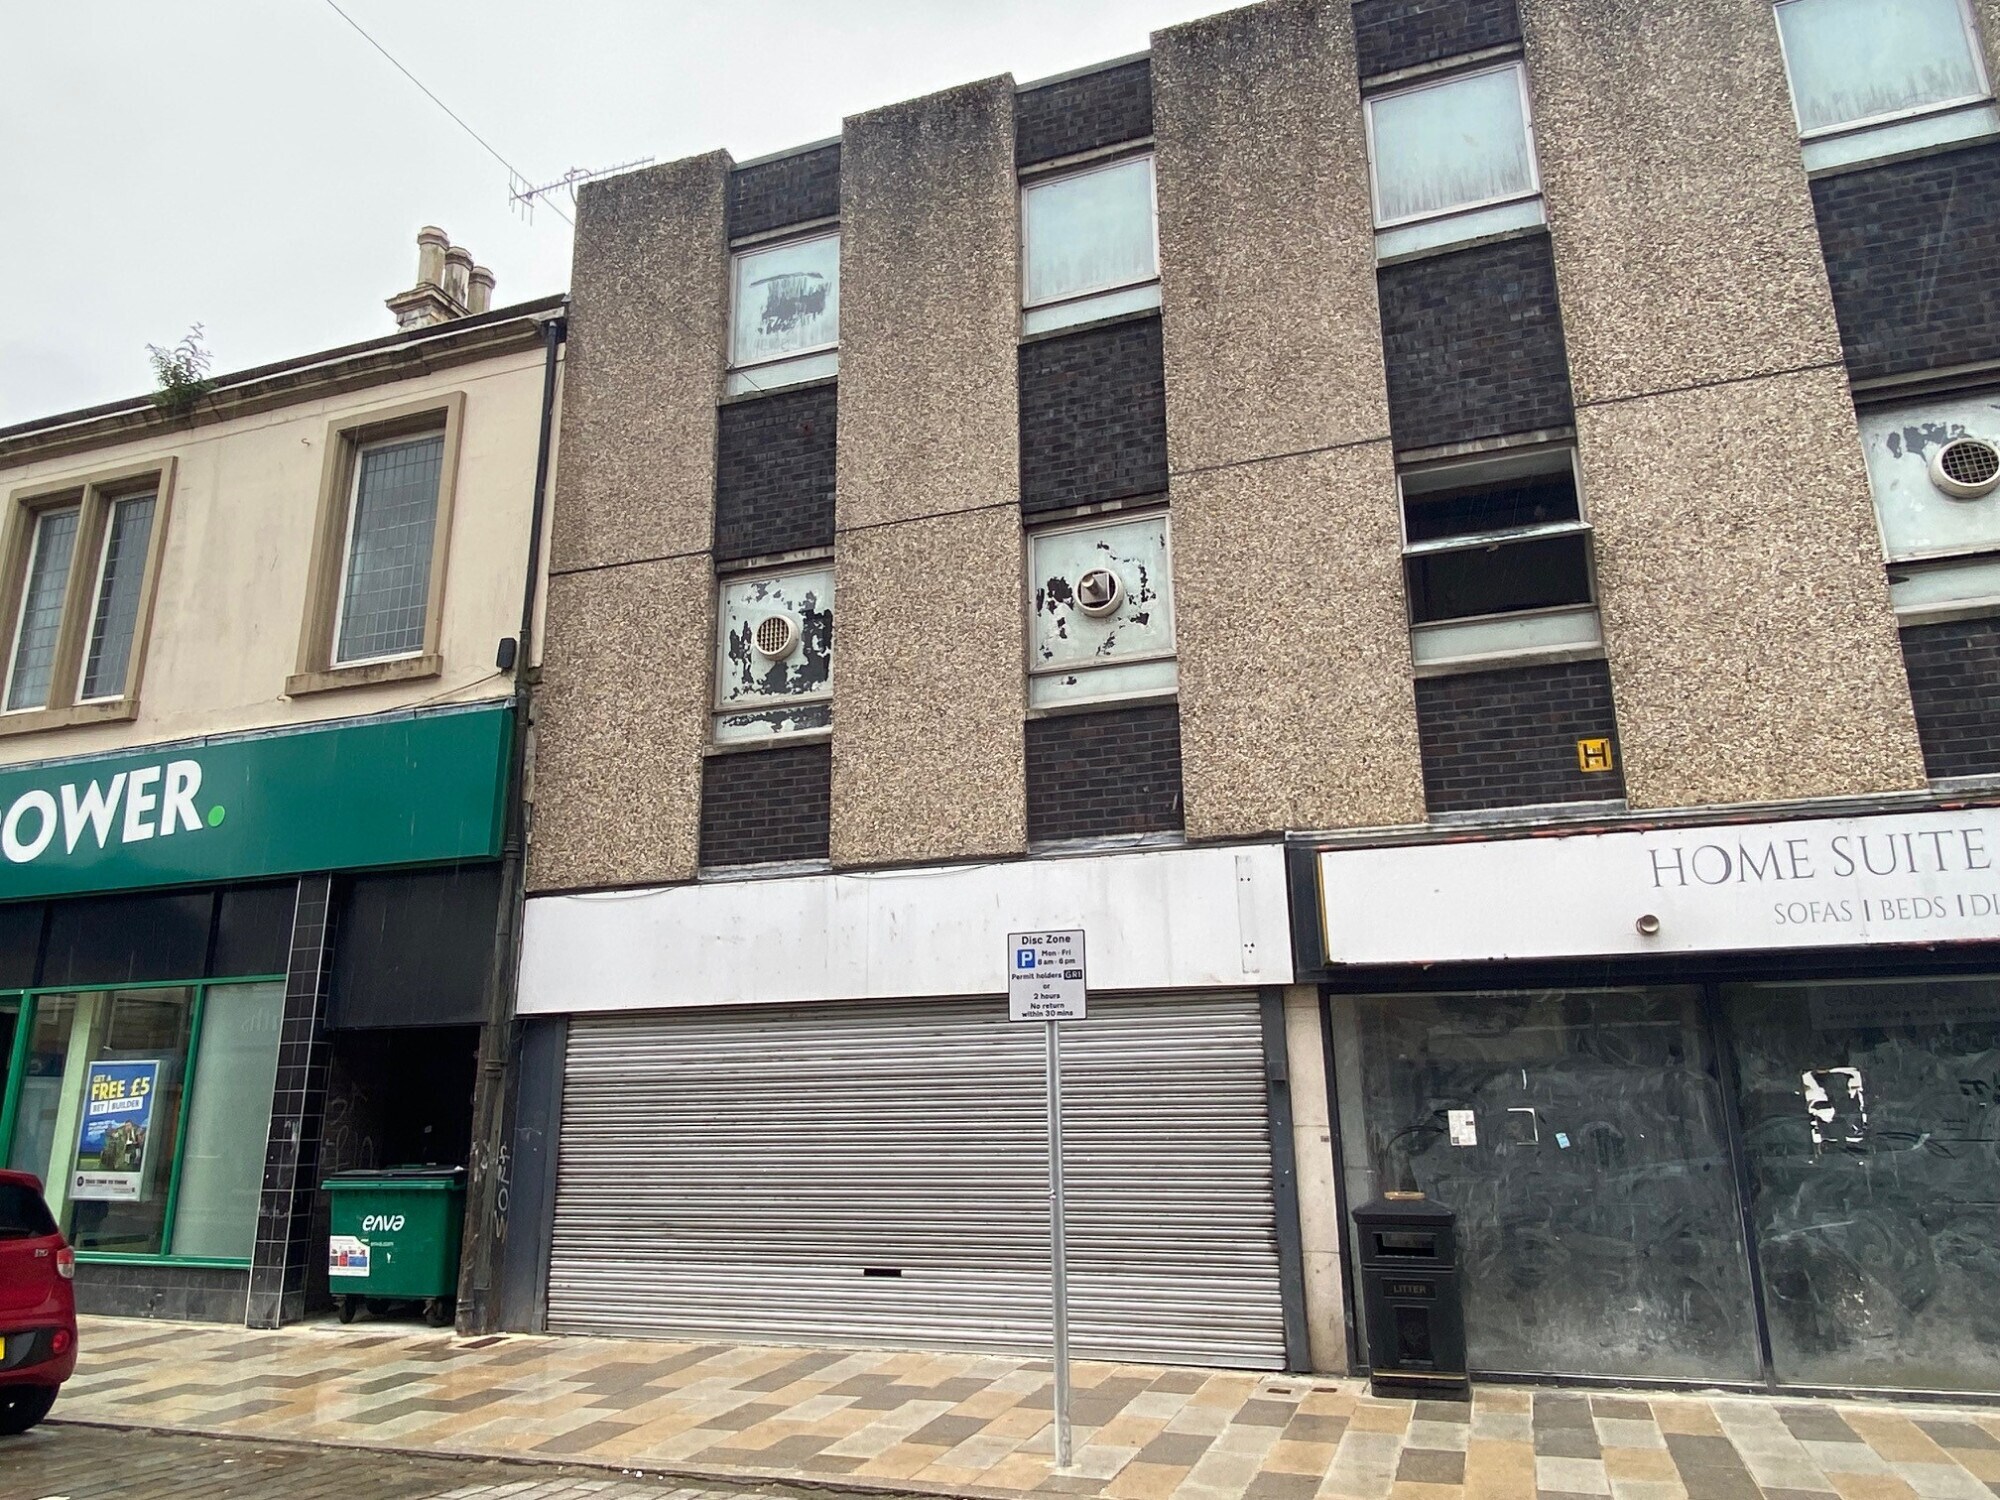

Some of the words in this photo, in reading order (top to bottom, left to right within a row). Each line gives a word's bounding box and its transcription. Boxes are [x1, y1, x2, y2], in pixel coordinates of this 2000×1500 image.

[1583, 742, 1607, 768] H
[1647, 839, 1815, 888] HOME
[1832, 828, 1991, 877] SUITE
[1775, 899, 1853, 925] SOFAS
[1881, 896, 1948, 921] BEDS
[1022, 936, 1043, 945] Disc
[1046, 935, 1071, 944] Zone
[1021, 951, 1033, 967] P
[91, 1080, 126, 1101] FREE
[130, 1077, 150, 1096] £5
[93, 1103, 105, 1112] BET
[111, 1099, 140, 1110] BUILDER
[362, 1215, 405, 1231] enva
[1393, 1285, 1426, 1294] LITTER
